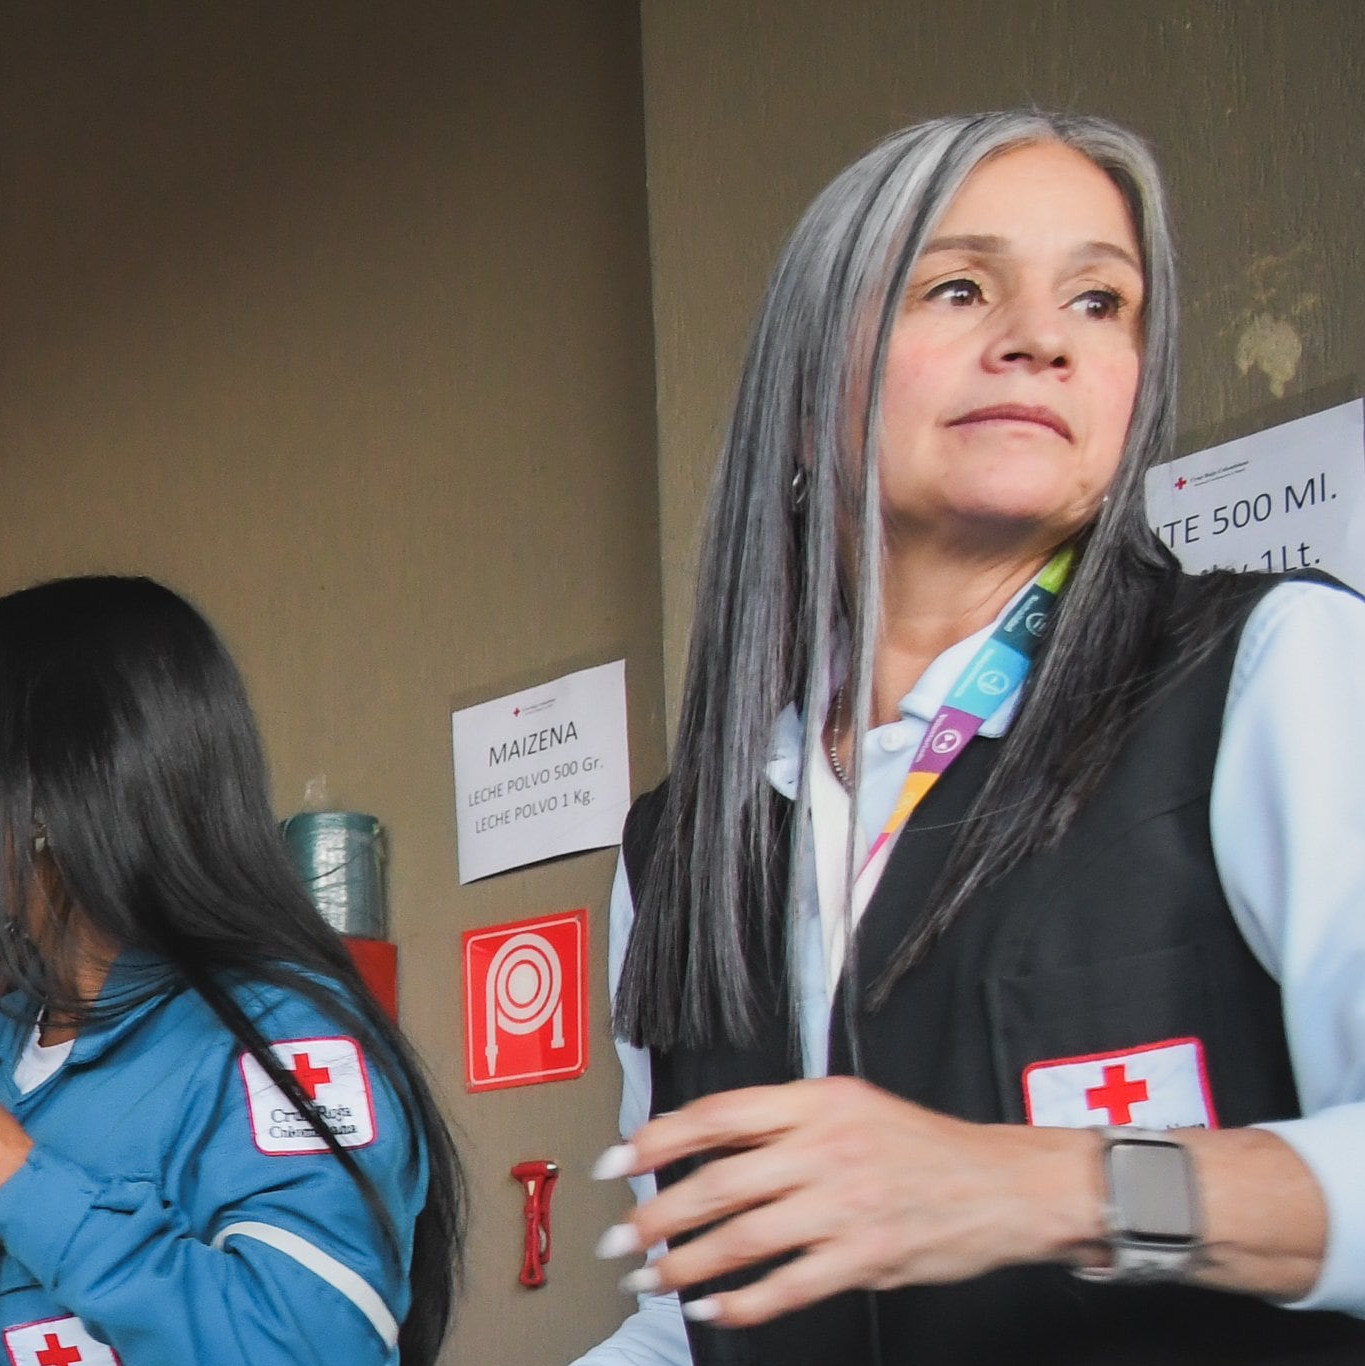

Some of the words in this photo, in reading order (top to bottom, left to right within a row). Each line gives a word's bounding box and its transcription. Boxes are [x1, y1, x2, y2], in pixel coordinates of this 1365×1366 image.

[1212, 493, 1272, 535] 500
[488, 721, 578, 767] MAIZENA
[468, 781, 504, 807] LECHE
[507, 769, 550, 796] POLVO
[554, 760, 579, 782] 500
[581, 755, 604, 775] Gr.
[475, 808, 511, 833] LECHE
[514, 796, 557, 823] POLVO
[562, 793, 569, 809] 1
[573, 787, 595, 808] Kg.
